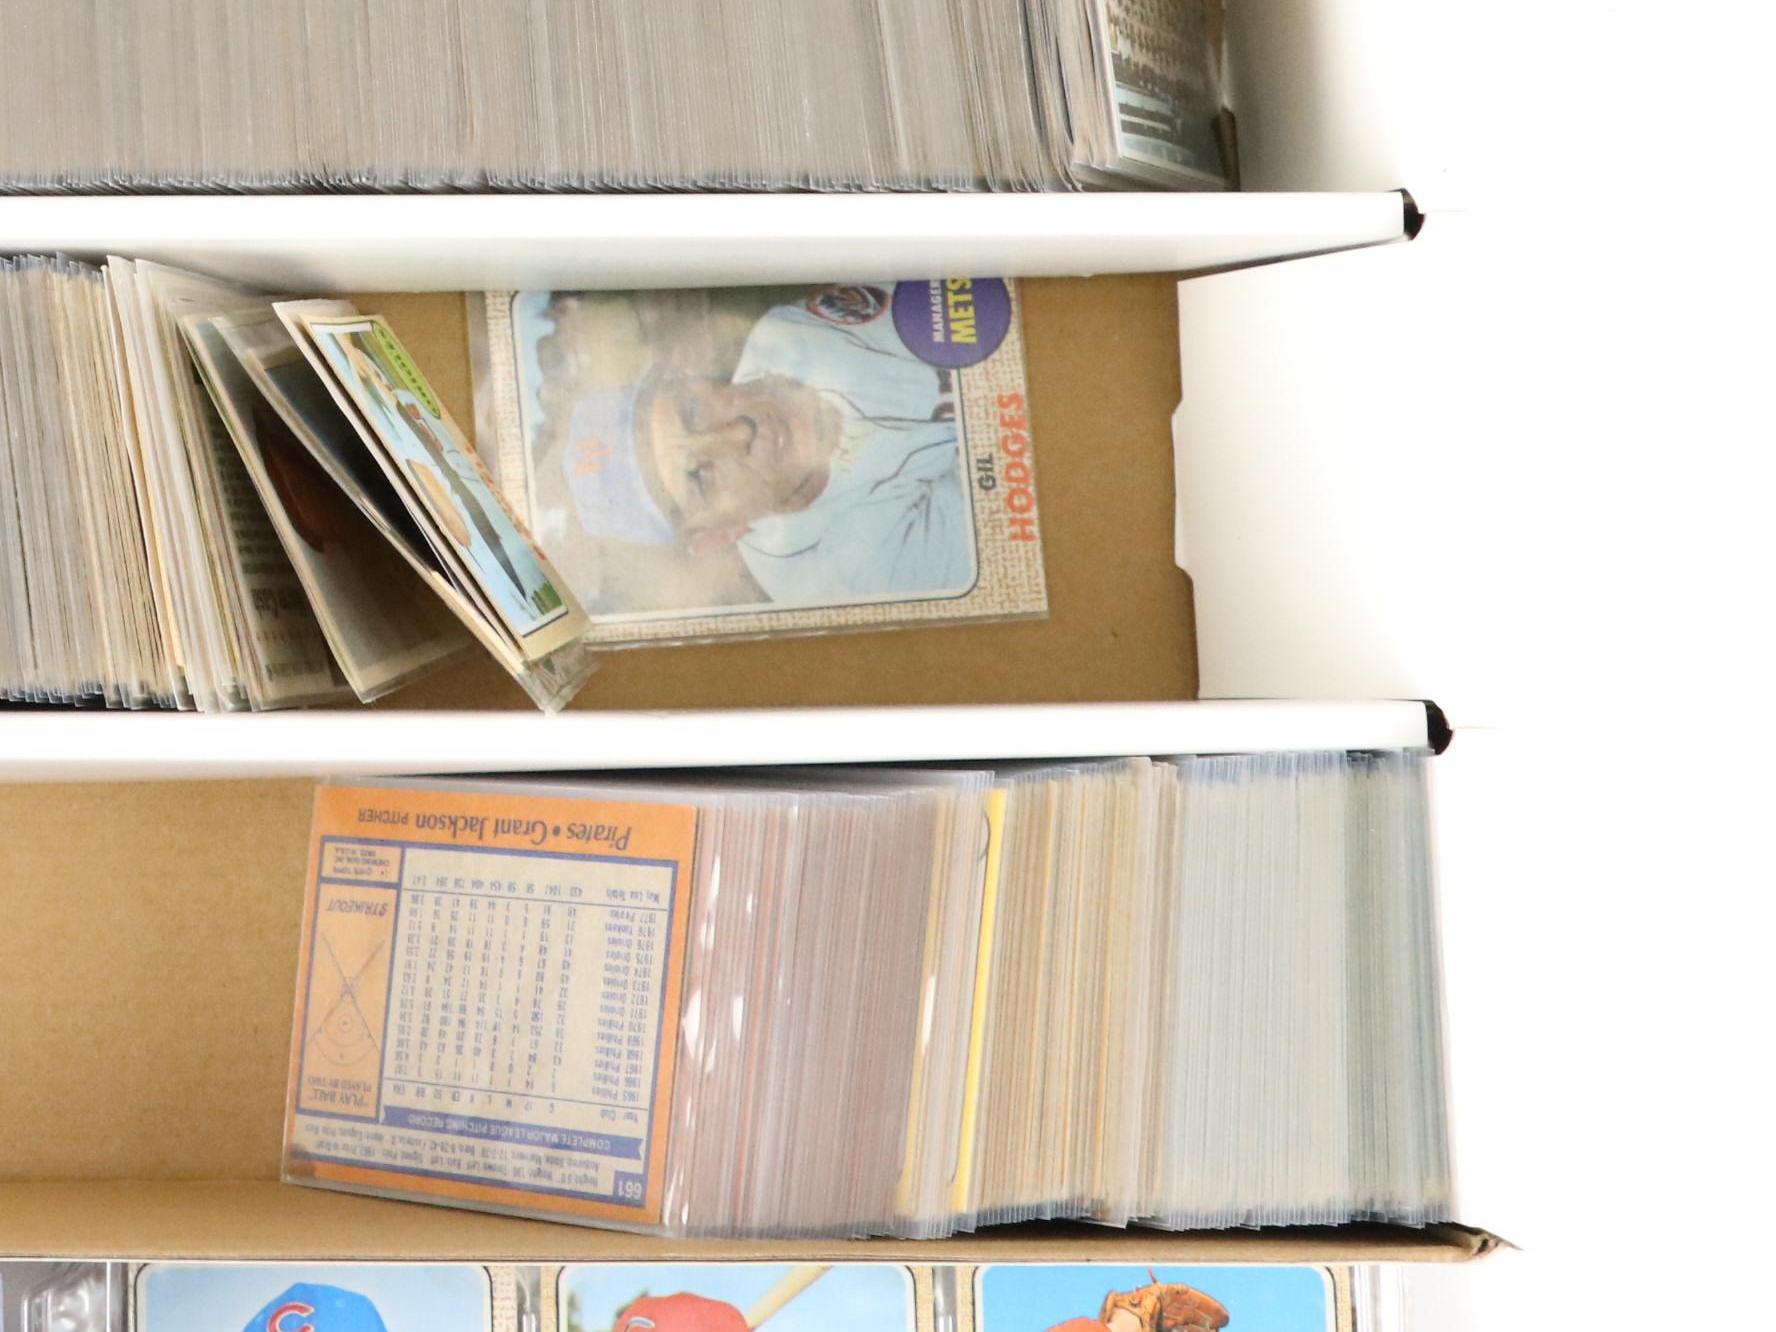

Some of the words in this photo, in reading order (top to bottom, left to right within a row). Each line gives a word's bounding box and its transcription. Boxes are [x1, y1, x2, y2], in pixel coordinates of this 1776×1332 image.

[930, 279, 945, 342] MANAGER
[946, 278, 977, 344] METS
[977, 453, 996, 491] GIL
[997, 392, 1036, 542] HODGES
[357, 808, 408, 824] PITCHER
[414, 812, 488, 840] Jackson
[492, 818, 548, 845] Grant
[565, 822, 631, 851] Pirates
[324, 898, 388, 917] STRIKEOUT
[490, 1124, 524, 1138] LEAGUE
[526, 1129, 558, 1143] MAJOR
[559, 1133, 610, 1149] COMPLETE
[617, 1180, 642, 1199] 661
